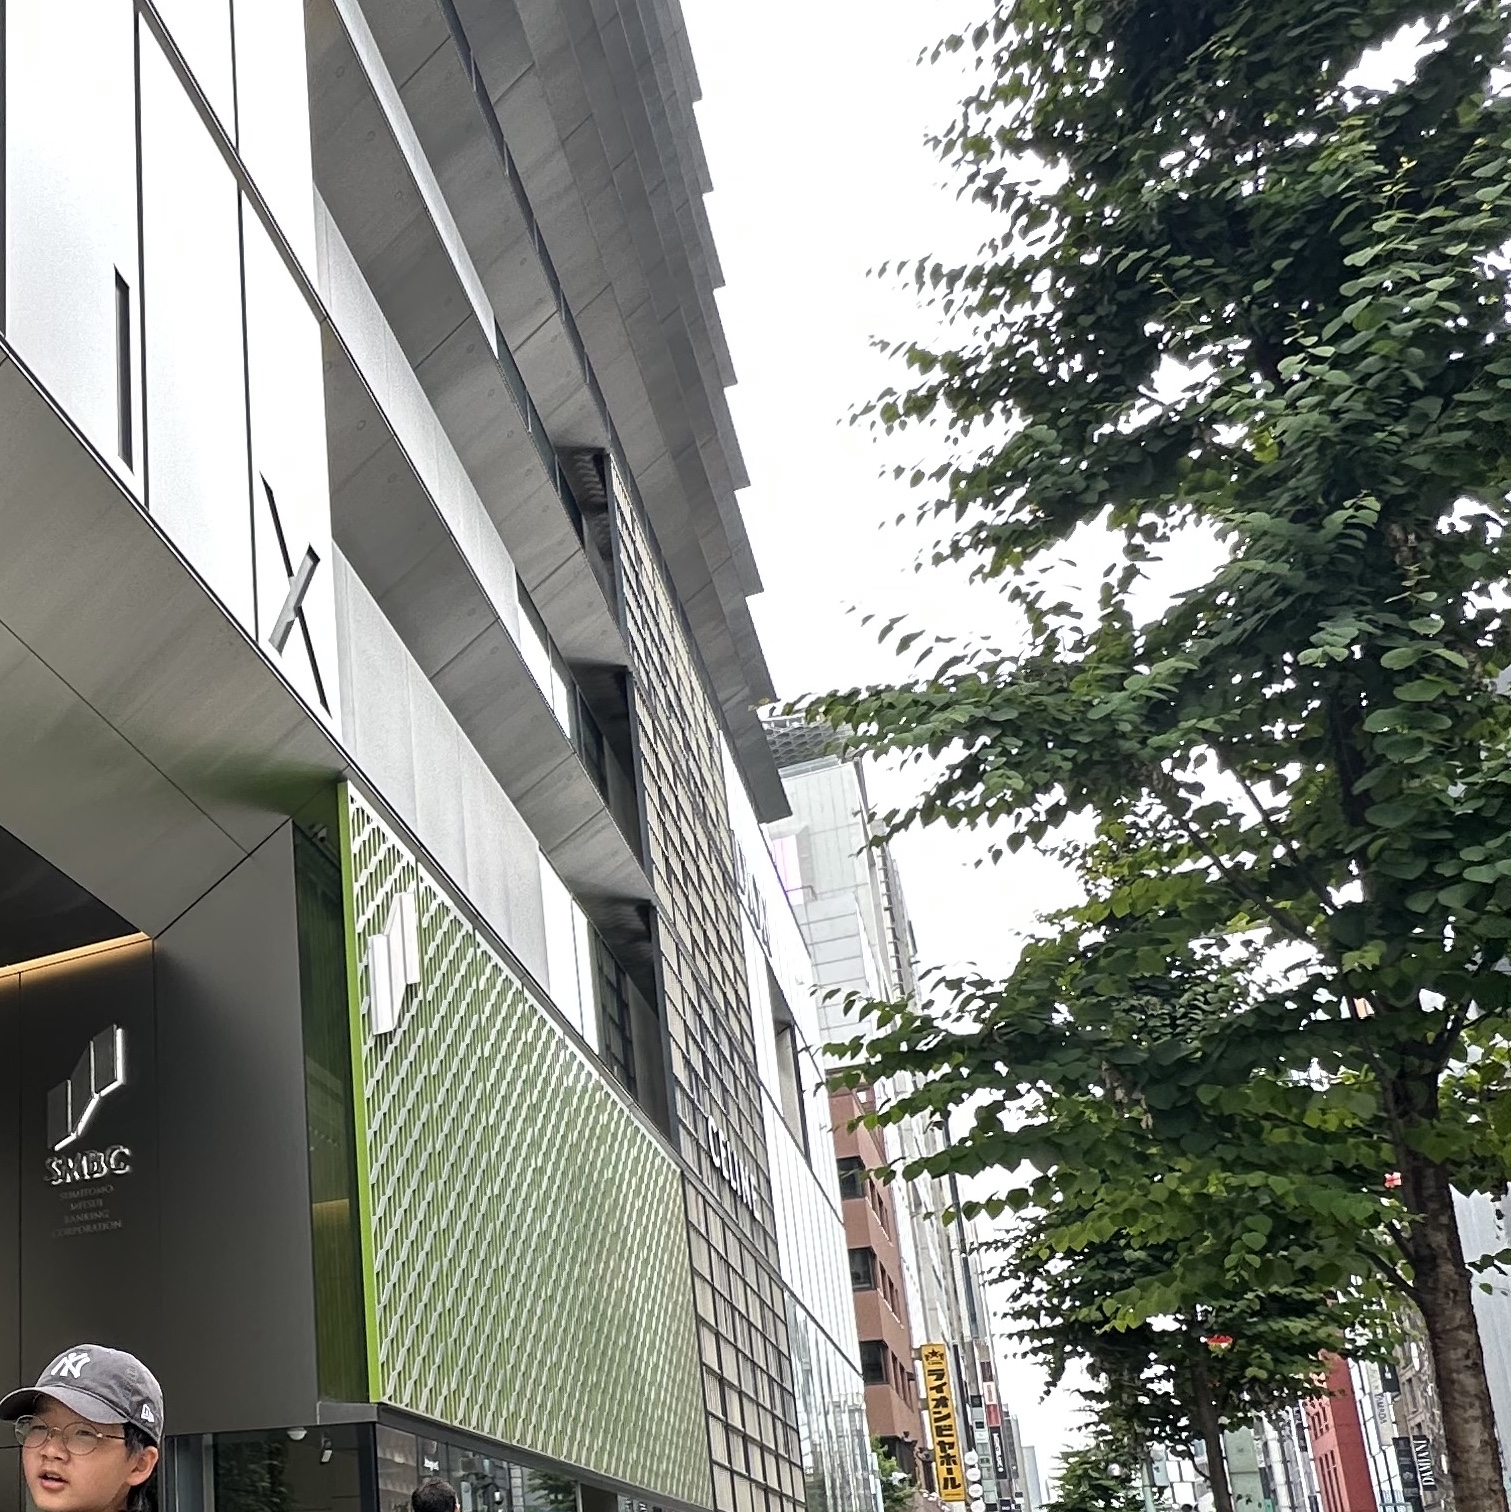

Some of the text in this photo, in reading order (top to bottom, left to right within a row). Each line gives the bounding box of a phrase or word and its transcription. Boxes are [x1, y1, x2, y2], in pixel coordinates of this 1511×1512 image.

[44, 1144, 132, 1186] SMBC
[707, 1114, 763, 1224] CELINE
[50, 1352, 91, 1379] NY
[927, 1368, 962, 1491] ライオンビヤホール
[1412, 1439, 1436, 1487] DAMIANI
